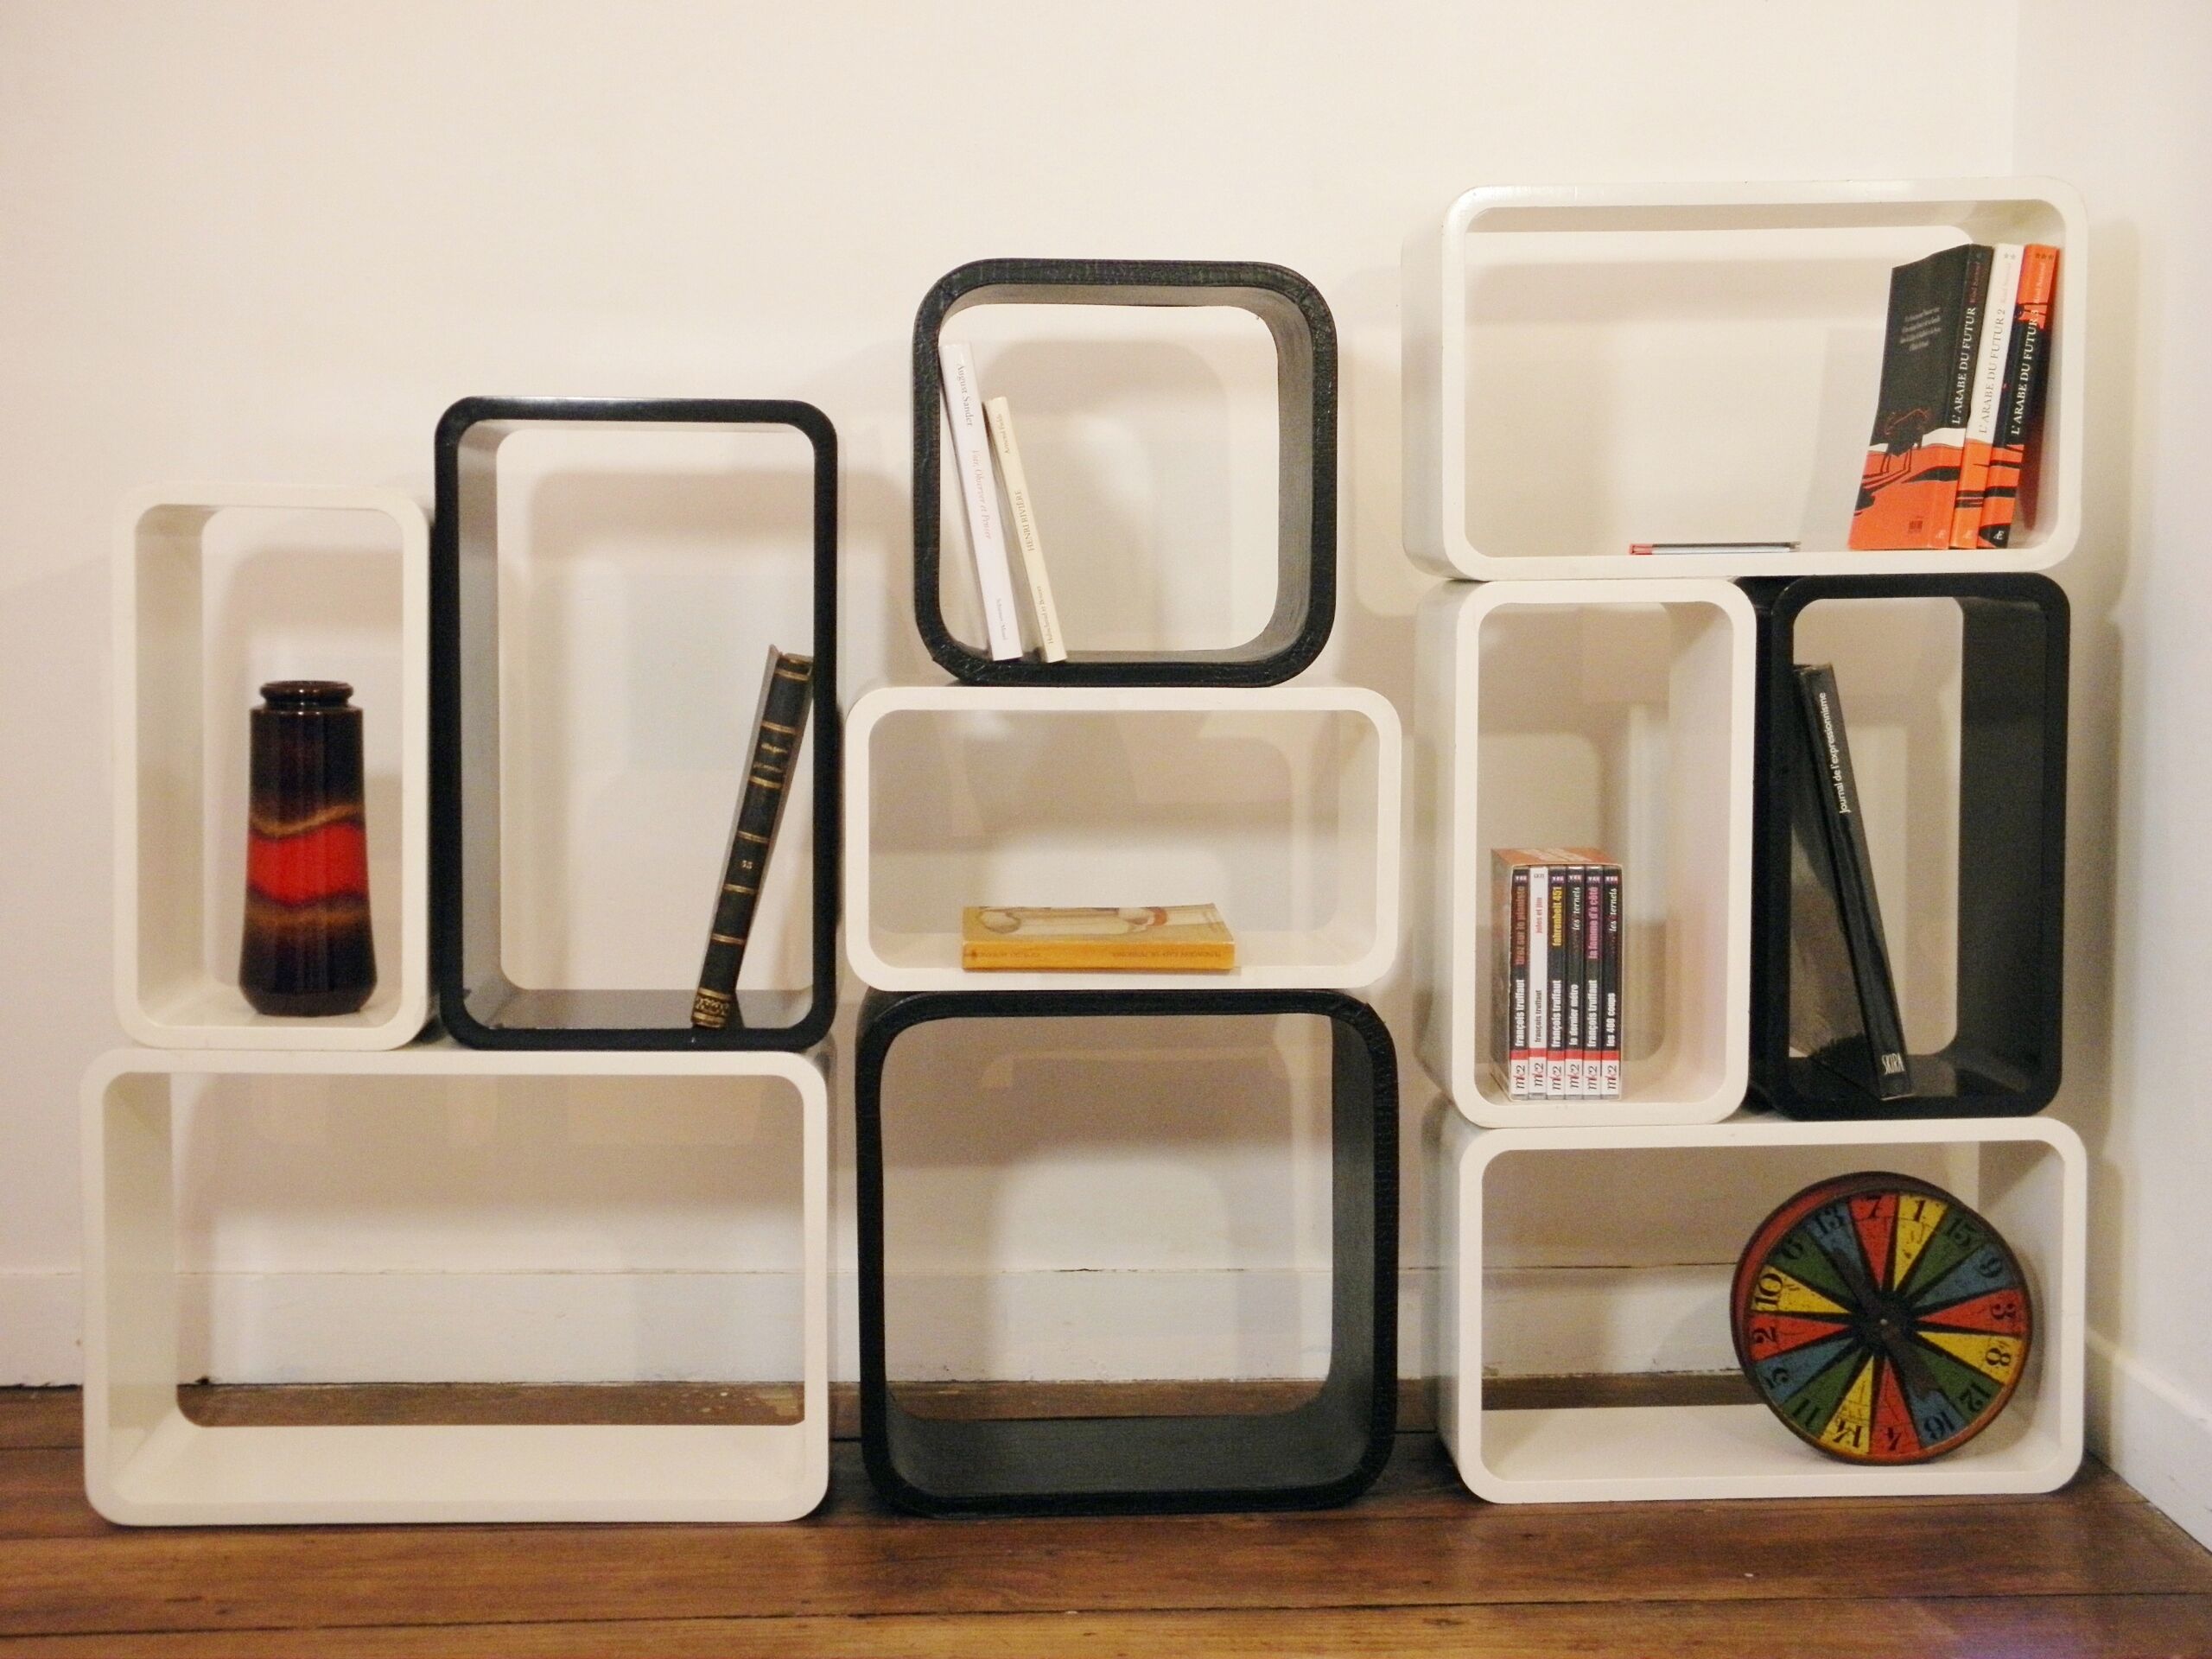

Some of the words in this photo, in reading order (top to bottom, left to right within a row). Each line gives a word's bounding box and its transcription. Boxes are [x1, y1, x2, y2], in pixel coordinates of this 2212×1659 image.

[1961, 306, 1976, 349] FUTUR
[1990, 317, 2004, 359] FUTUR
[2022, 318, 2038, 360] FUTUR
[1959, 353, 1970, 370] DU
[1986, 362, 1997, 379] DU
[2019, 363, 2031, 381] DU
[957, 364, 969, 394] August
[962, 396, 974, 427] Sander
[1023, 524, 1035, 552] HENRI
[1819, 691, 1840, 769] l'expressionnisme
[1832, 769, 1842, 782] de
[1553, 887, 1561, 900] 451
[1571, 887, 1580, 919] ternels
[1608, 888, 1617, 920] ternels
[1552, 902, 1561, 945] fahrenheit
[1572, 919, 1580, 931] les
[1516, 979, 1524, 1011] truffaut
[1552, 980, 1560, 1011] truffaut
[1569, 984, 1579, 1007] métro
[1587, 980, 1597, 1011] truffaut
[1607, 993, 1616, 1016] coups
[1515, 1012, 1525, 1046] françois
[1552, 1013, 1562, 1047] françois
[1569, 1008, 1578, 1036] dernier
[1587, 1013, 1599, 1046] françois
[1606, 1018, 1615, 1033] 400
[1606, 1035, 1615, 1046] les
[1881, 1052, 1904, 1076] SKIRA
[1861, 1196, 1882, 1219] 7
[1911, 1200, 1926, 1223] 1
[1946, 1216, 1977, 1248] 15
[1980, 1257, 2003, 1278] 9
[1755, 1272, 1785, 1307] 10
[1990, 1302, 2017, 1320] 3
[1751, 1326, 1777, 1344] 2
[1985, 1347, 2012, 1367] 8
[1960, 1383, 1992, 1412] 12
[1885, 1426, 1902, 1452] 4
